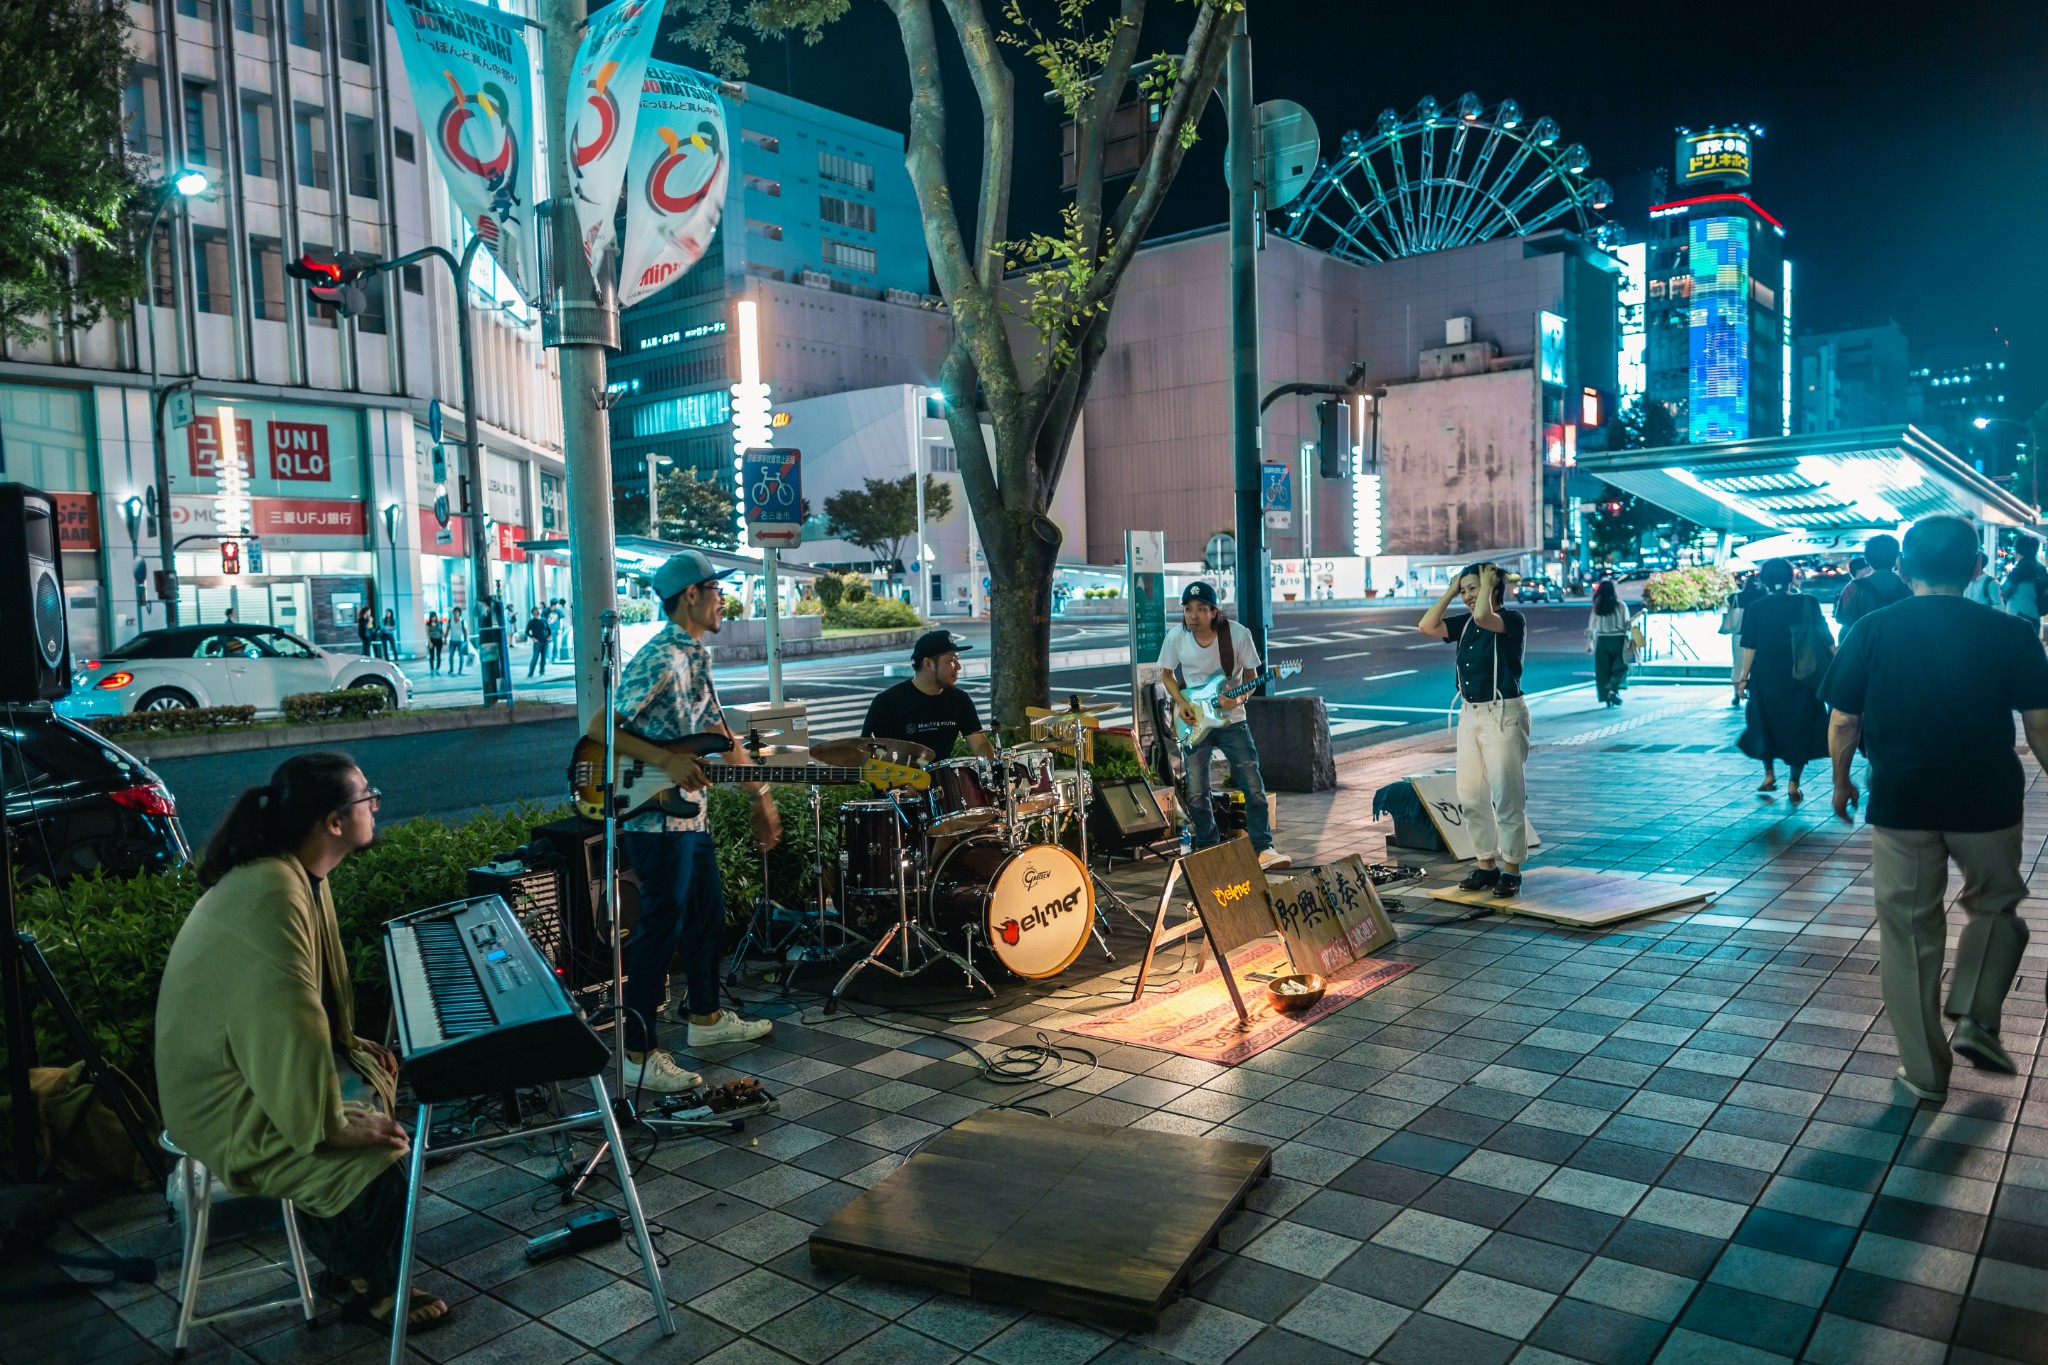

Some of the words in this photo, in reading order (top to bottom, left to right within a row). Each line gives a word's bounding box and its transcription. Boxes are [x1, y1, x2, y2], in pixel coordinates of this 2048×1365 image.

[490, 22, 512, 46] TO
[274, 427, 319, 452] UNI
[277, 452, 324, 476] QLO
[270, 510, 352, 526] 三菱UFJ銀行
[60, 527, 91, 541] AAR
[1280, 577, 1300, 587] 8/19
